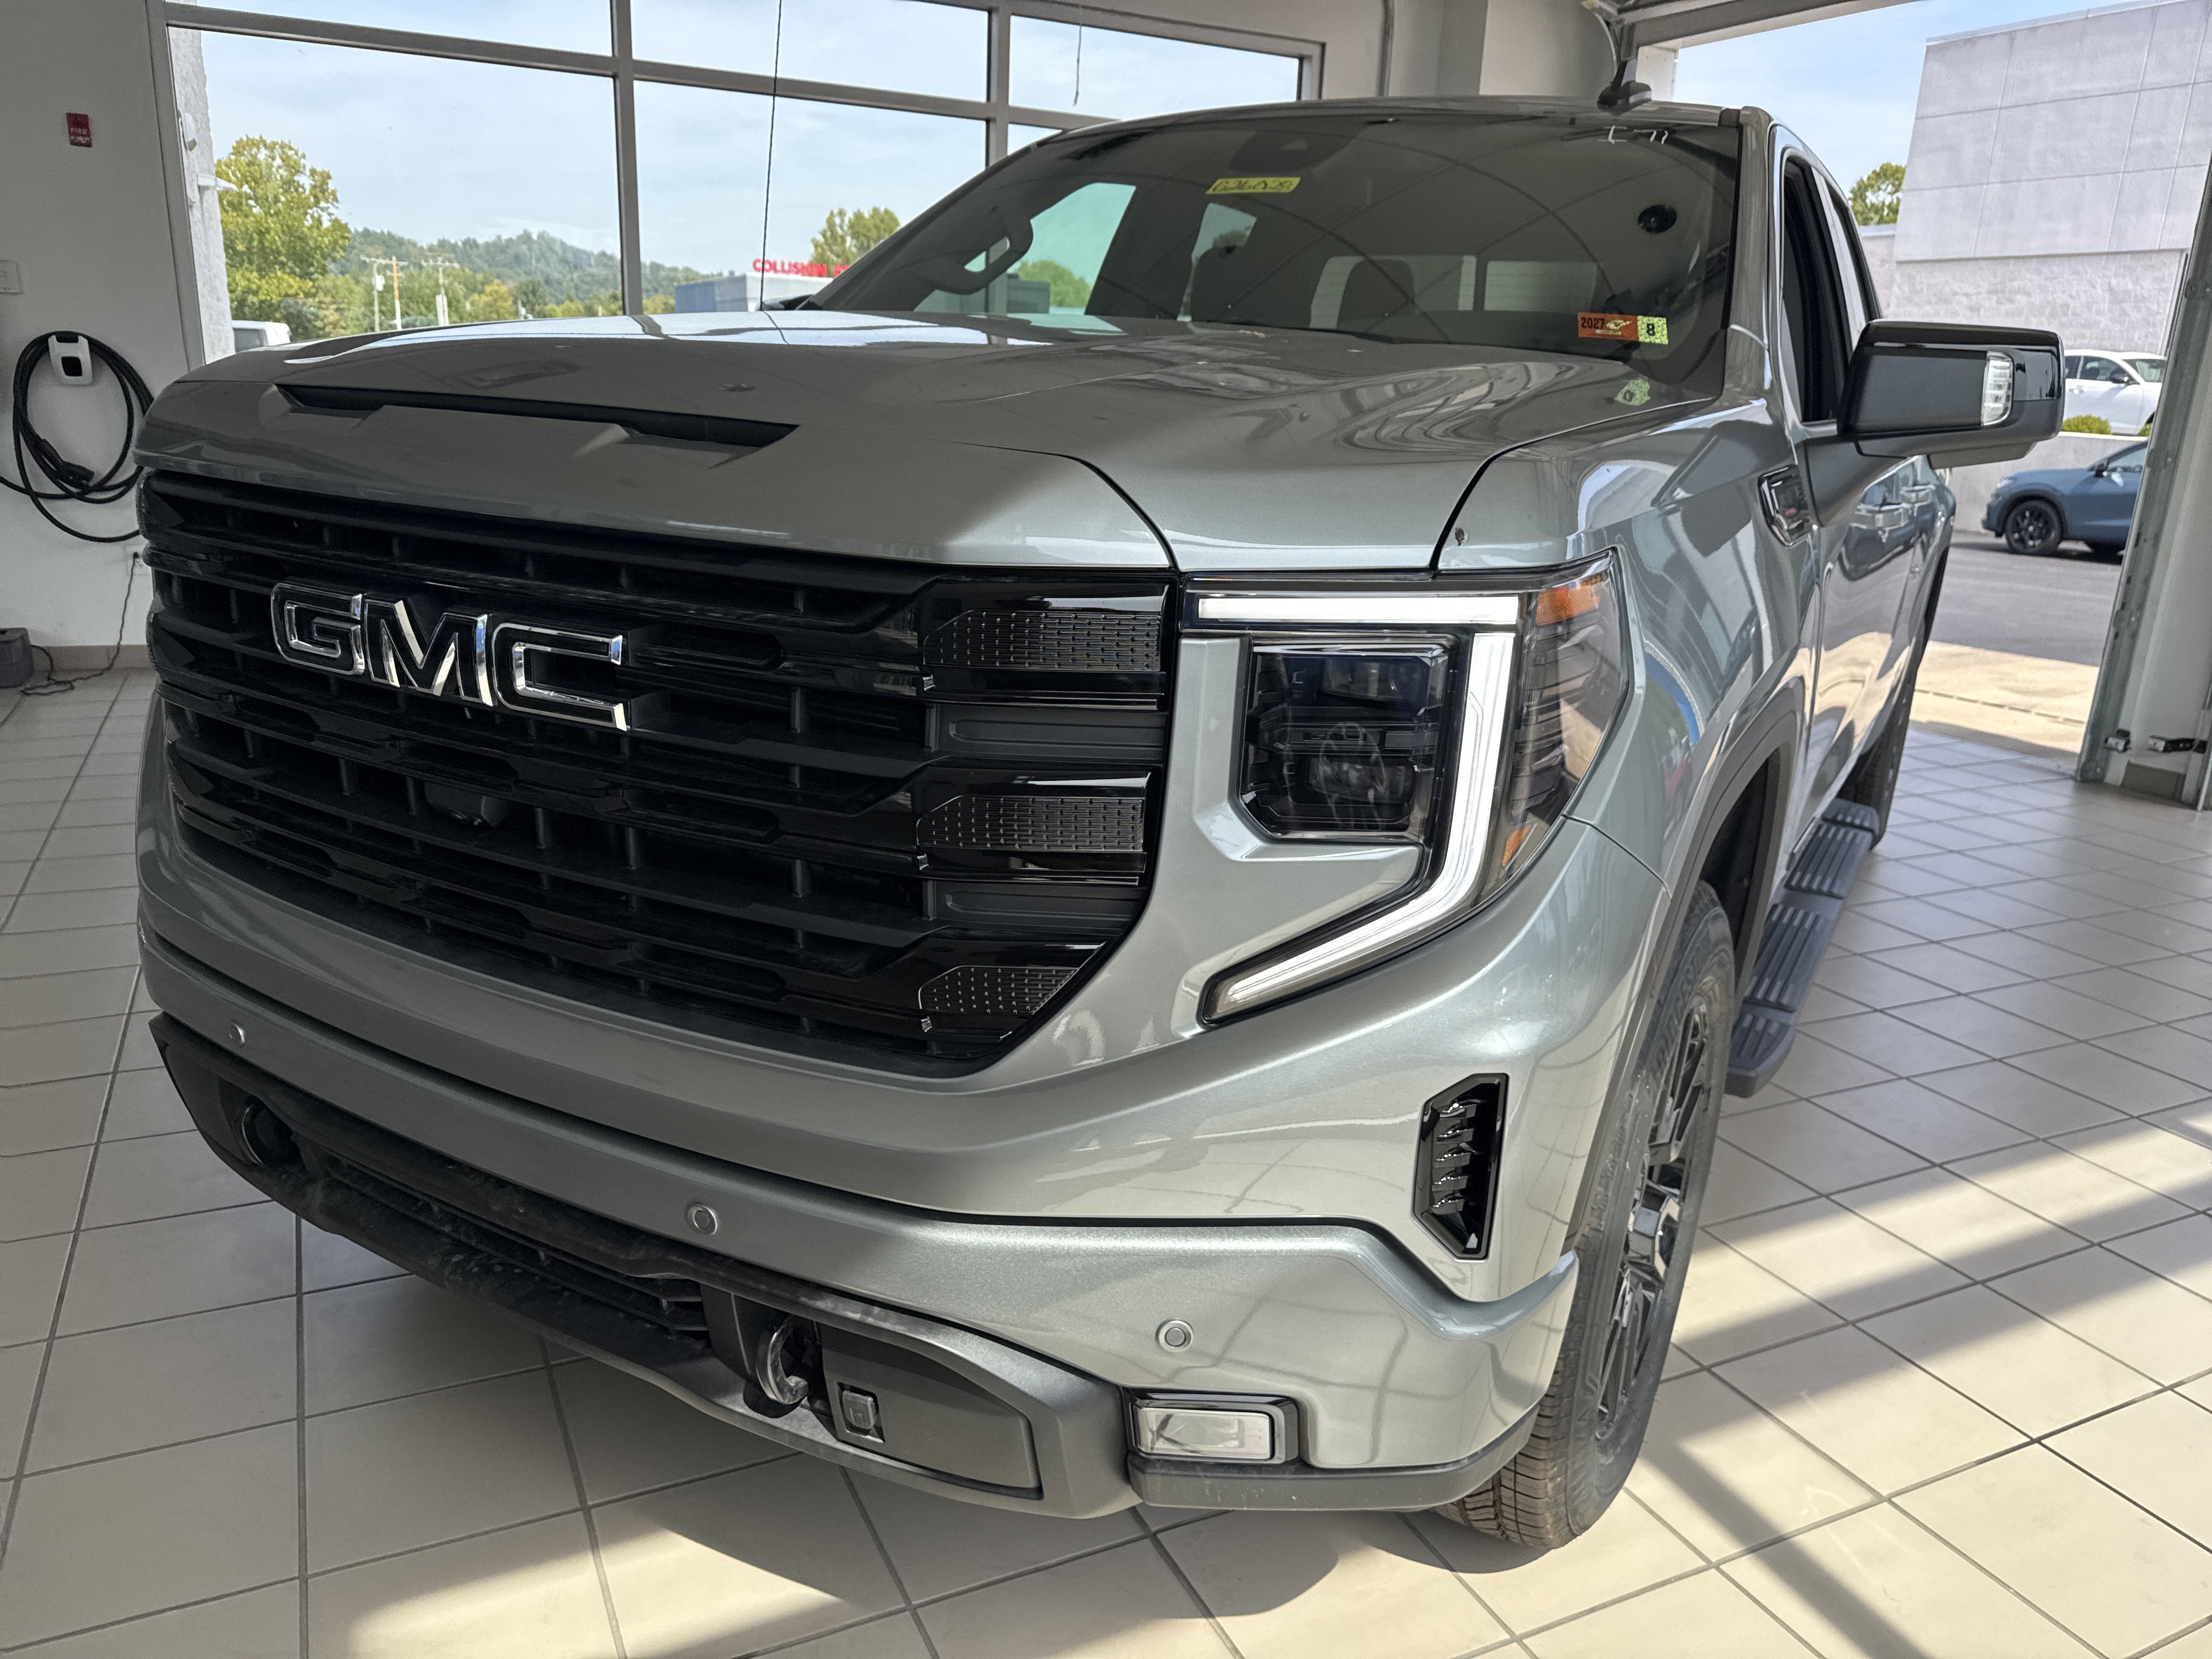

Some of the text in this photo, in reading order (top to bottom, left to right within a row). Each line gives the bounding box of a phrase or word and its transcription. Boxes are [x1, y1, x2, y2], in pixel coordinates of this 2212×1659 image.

[753, 258, 827, 277] COLLISION
[1581, 317, 1605, 329] 2027
[1646, 323, 1656, 336] 8
[271, 583, 630, 731] GMC
